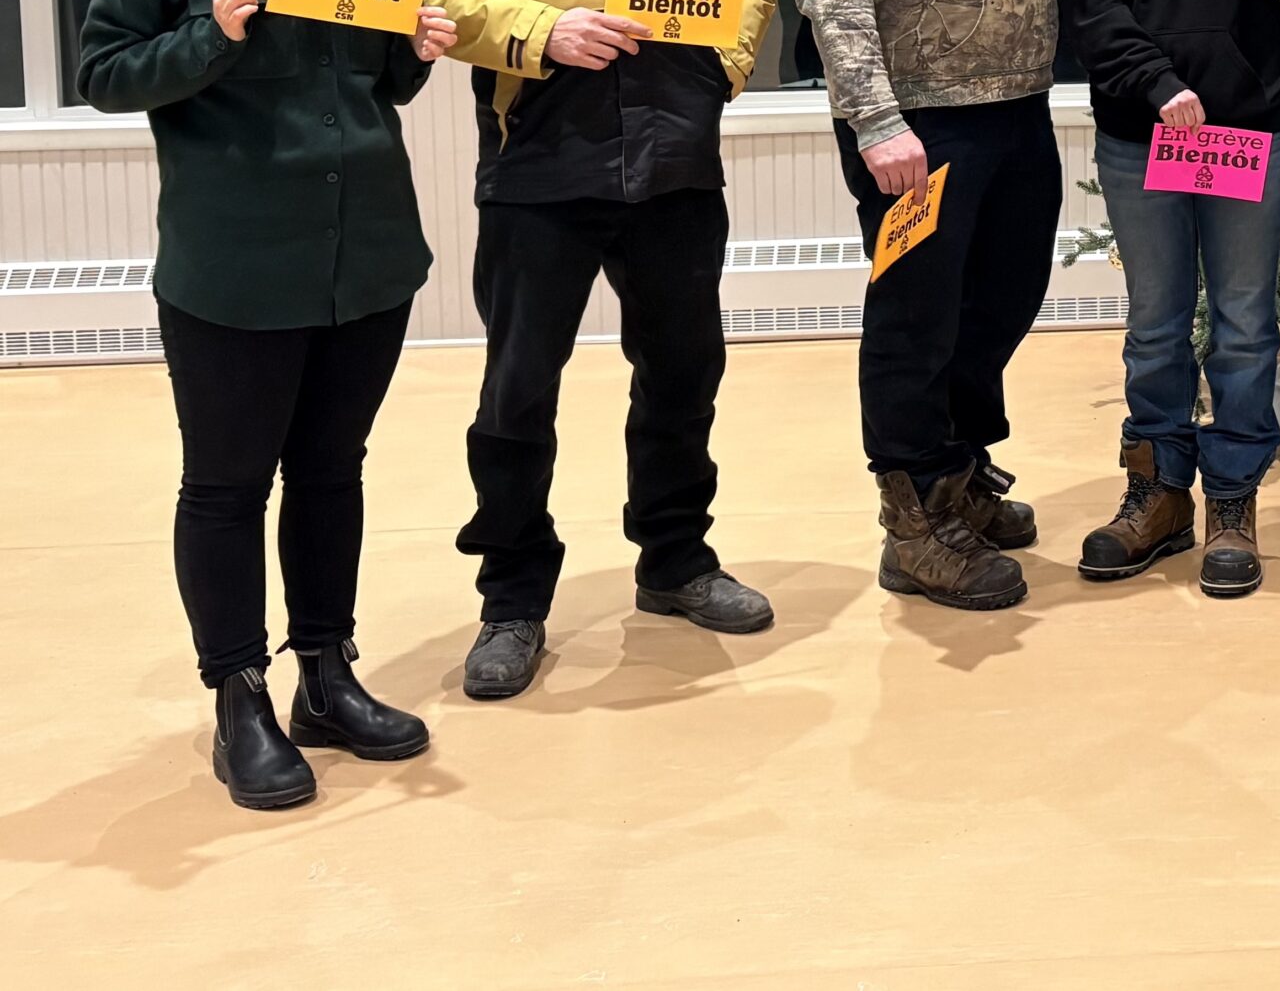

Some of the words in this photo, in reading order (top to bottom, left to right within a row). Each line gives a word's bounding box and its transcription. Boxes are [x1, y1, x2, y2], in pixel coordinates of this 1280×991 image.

[334, 11, 354, 21] CSN
[663, 31, 681, 39] CSN
[1158, 125, 1188, 142] En
[1197, 130, 1264, 150] grève
[1154, 143, 1261, 171] Bientôt
[1194, 181, 1213, 189] CSN
[890, 202, 905, 224] En
[885, 201, 931, 250] Bientôt
